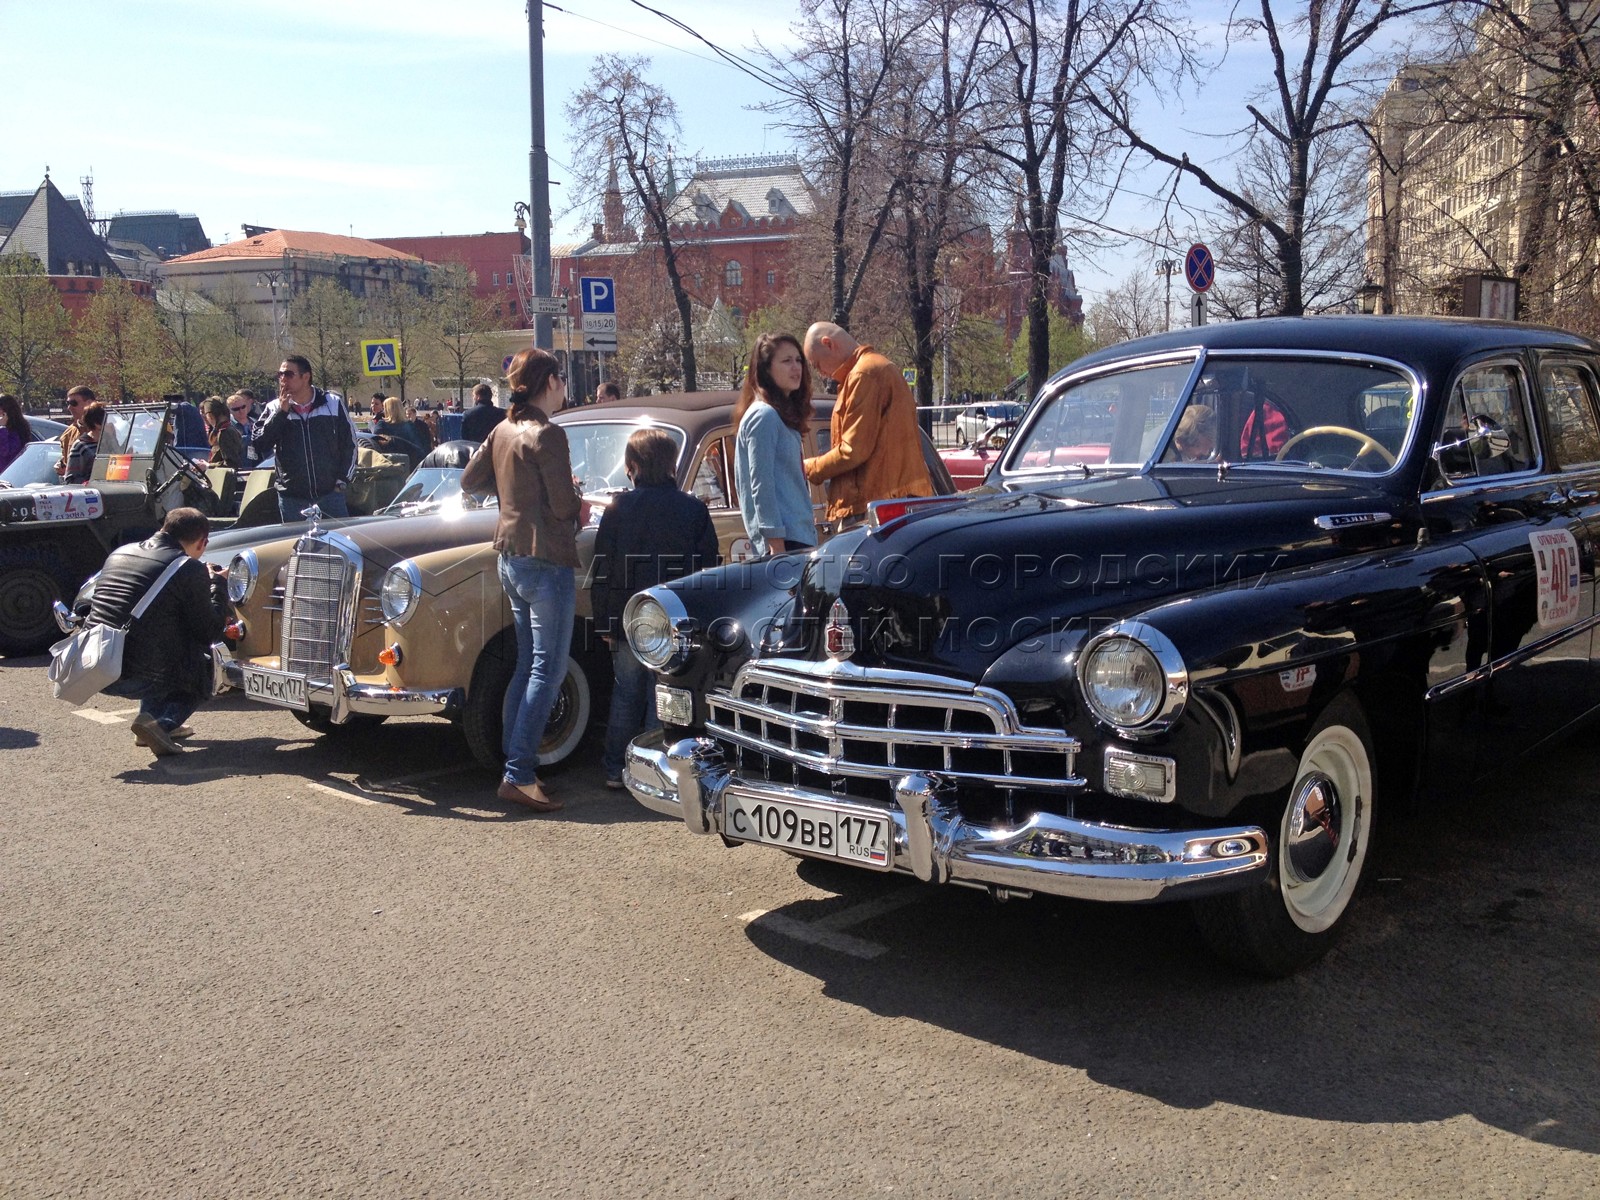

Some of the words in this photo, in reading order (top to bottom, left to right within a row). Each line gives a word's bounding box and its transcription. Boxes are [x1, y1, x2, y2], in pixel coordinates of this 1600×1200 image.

[589, 281, 609, 310] P
[603, 318, 614, 328] 20
[60, 492, 77, 513] 2
[1551, 548, 1569, 603] 40
[286, 678, 302, 696] 177
[732, 804, 834, 849] С109ВВ
[839, 816, 881, 848] 177
[849, 844, 870, 857] RUS
